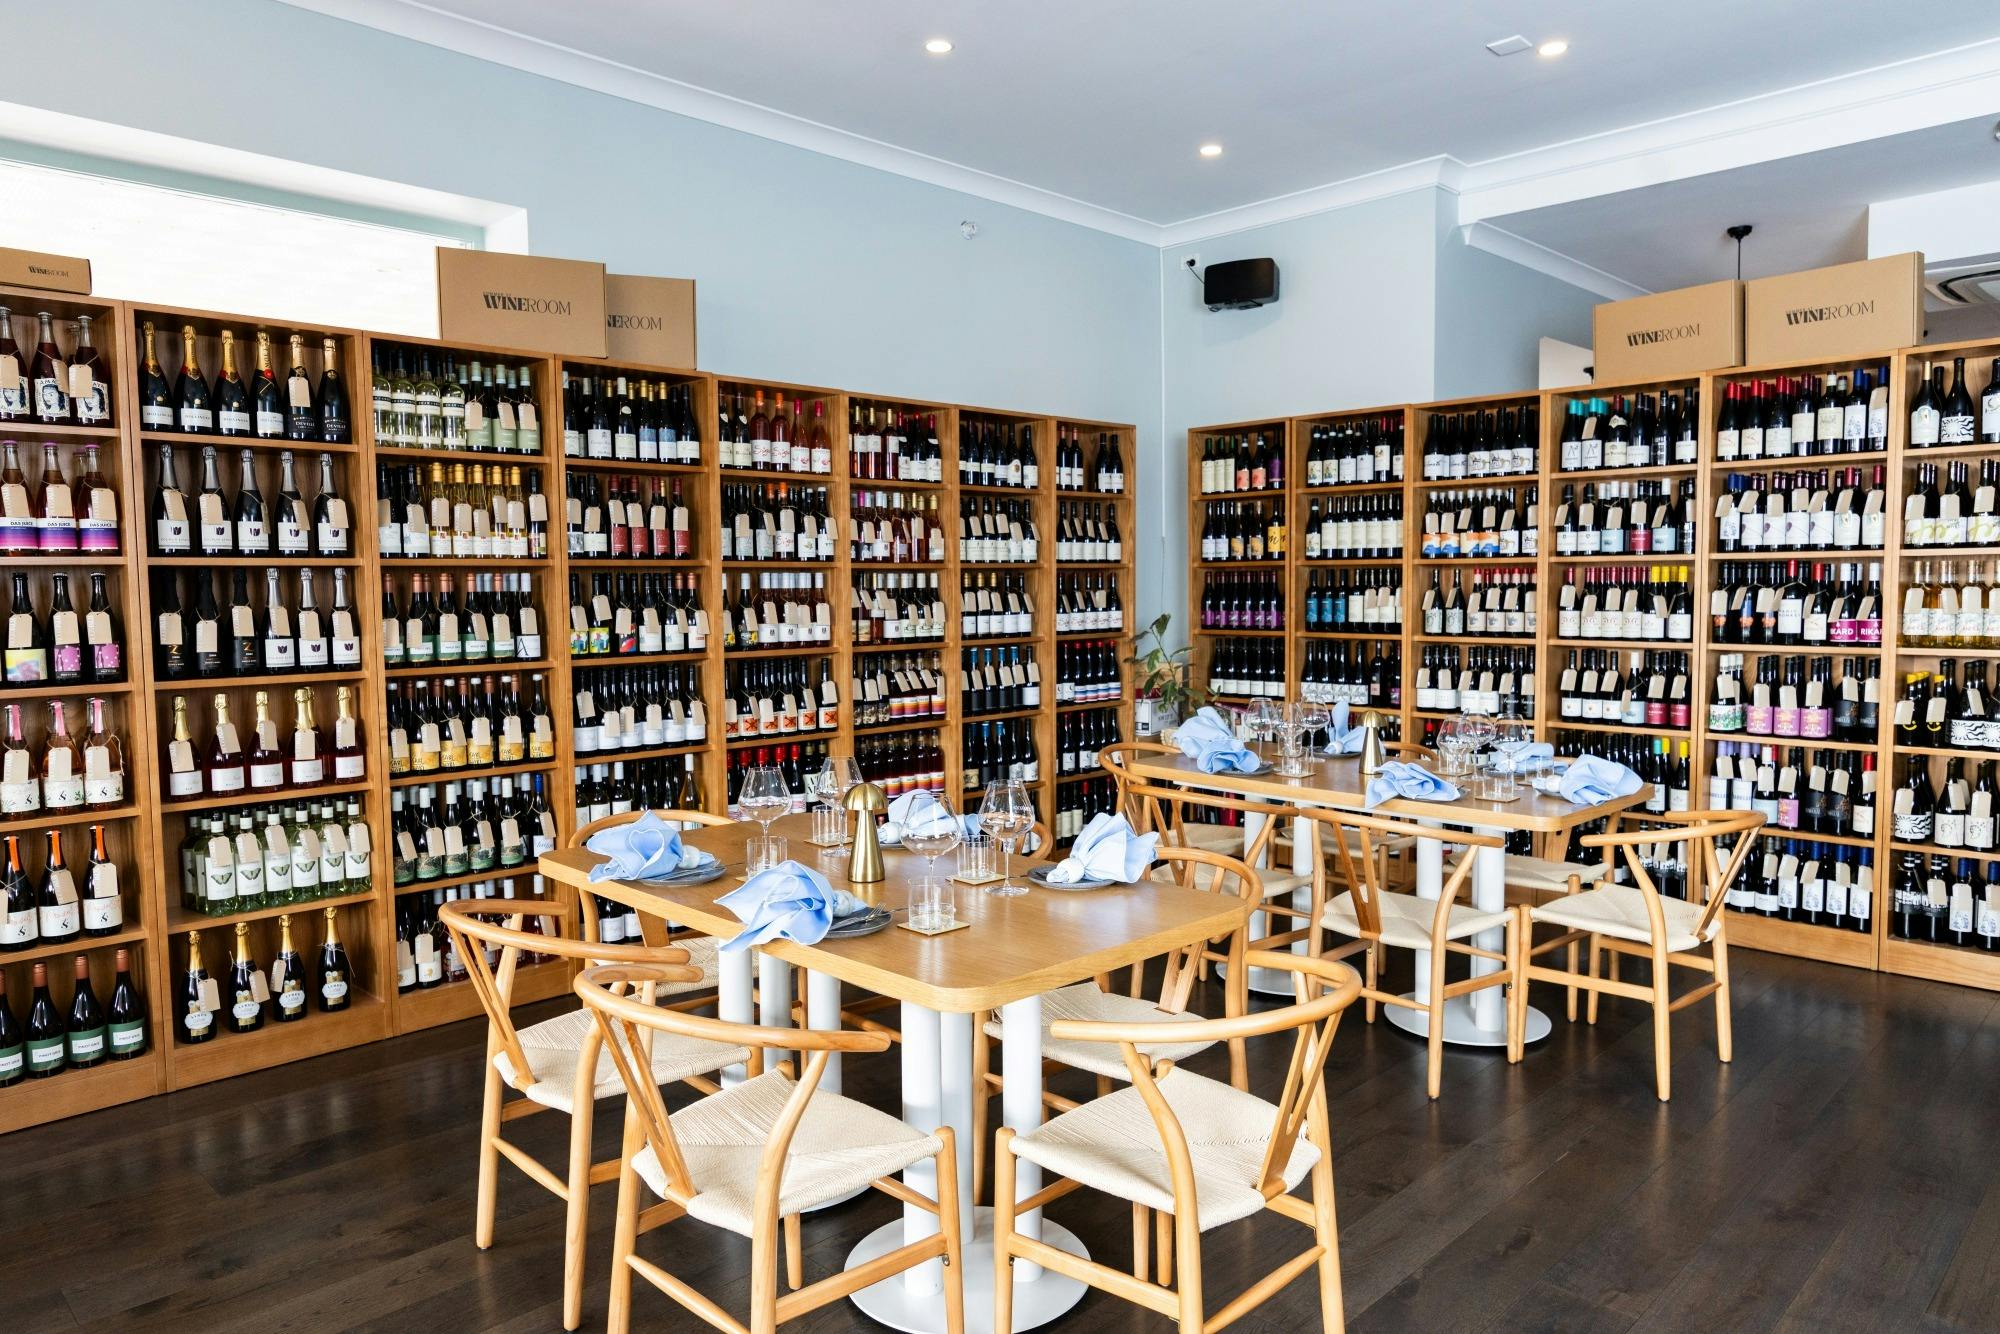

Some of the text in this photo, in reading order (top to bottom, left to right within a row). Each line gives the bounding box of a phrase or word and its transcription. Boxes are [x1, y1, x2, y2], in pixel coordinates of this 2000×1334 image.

[483, 294, 571, 316] WINEROOM
[1786, 300, 1875, 326] WINEROOM
[607, 314, 662, 331] NEROOM
[1627, 323, 1701, 347] WINEROOM
[1860, 627, 1882, 636] RIKA
